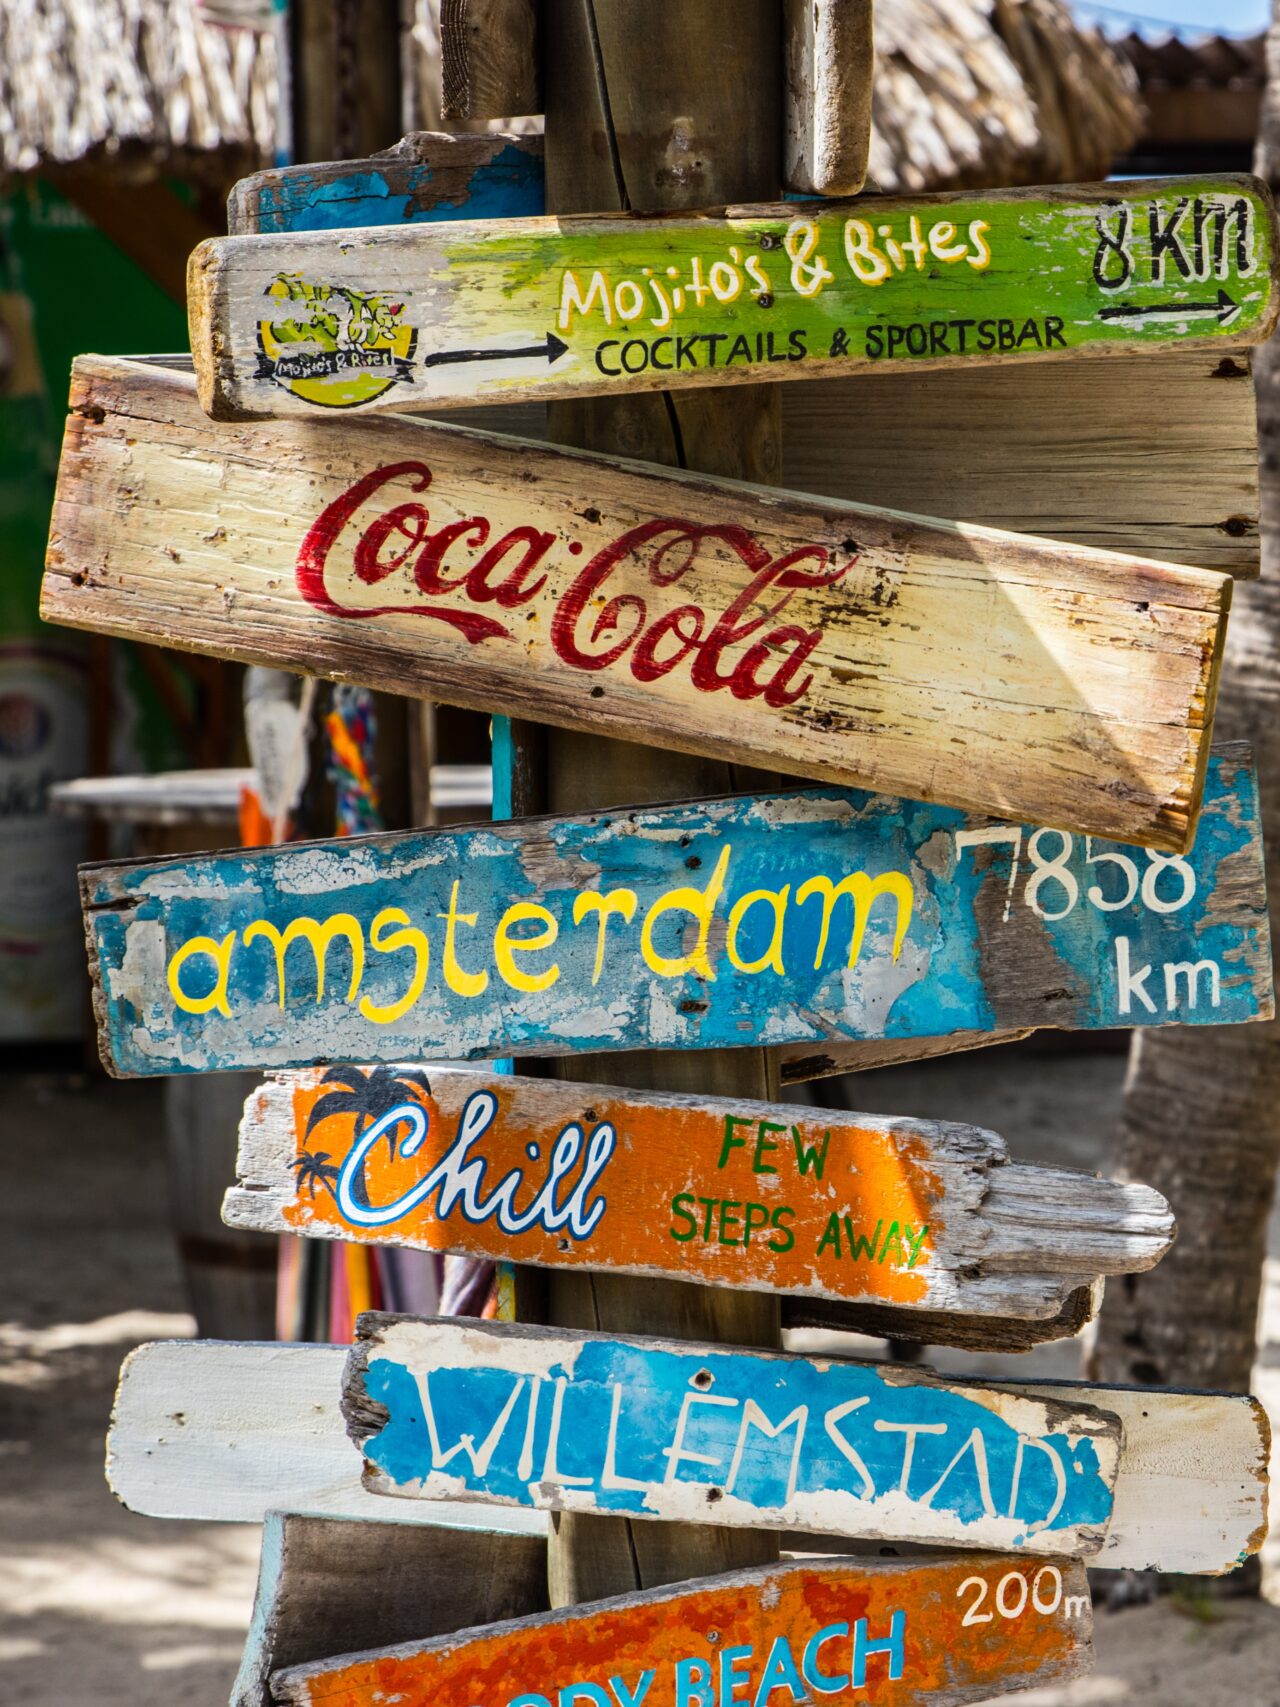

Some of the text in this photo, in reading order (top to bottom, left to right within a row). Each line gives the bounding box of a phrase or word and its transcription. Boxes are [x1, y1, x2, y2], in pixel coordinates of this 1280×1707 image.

[556, 215, 992, 332] Mojito's & Bites
[1093, 197, 1136, 296] 8
[595, 314, 1069, 377] COCKTAILS & SPORTSBAR
[954, 826, 1197, 923] 7858
[167, 844, 915, 1024] amsterdam
[1114, 935, 1222, 1015] km
[336, 1089, 619, 1241] Chill
[717, 1115, 832, 1181] FEW
[670, 1192, 931, 1269] STEPS AWAY
[414, 1372, 1068, 1534] WILLEMSTAD
[674, 1609, 908, 1707] BEACH
